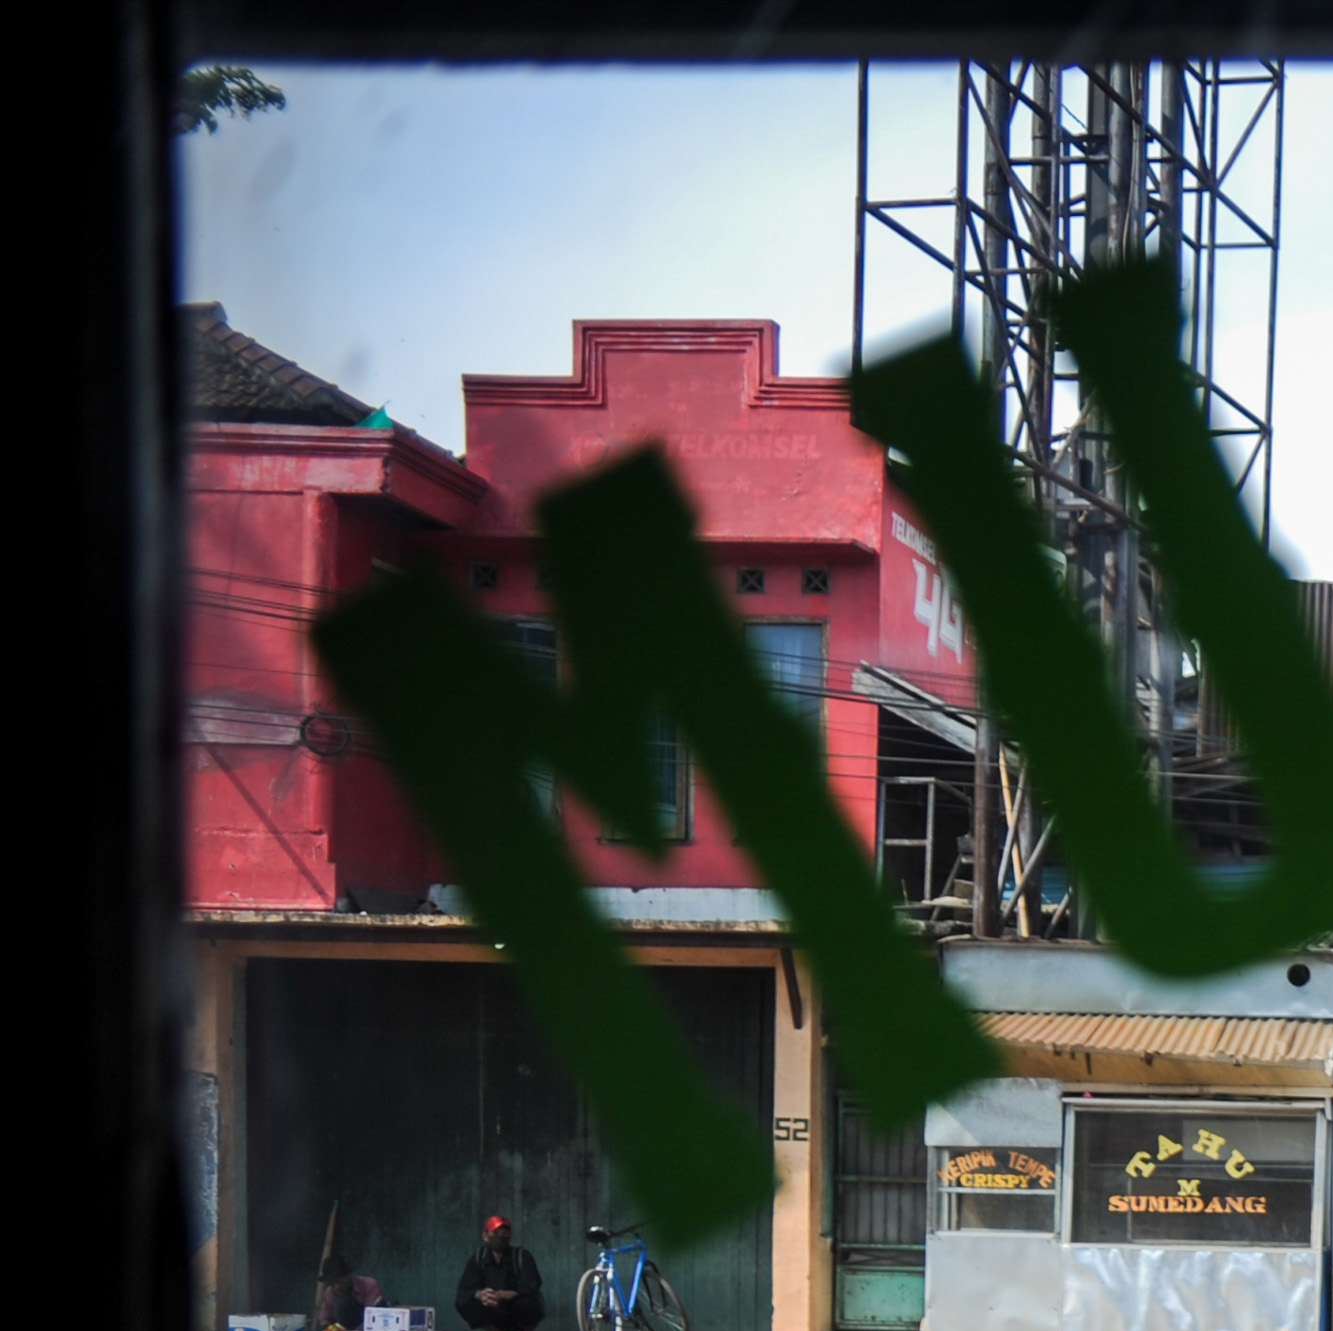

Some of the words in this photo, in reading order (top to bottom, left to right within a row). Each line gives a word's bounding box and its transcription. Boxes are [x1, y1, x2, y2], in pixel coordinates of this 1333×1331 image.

[775, 1117, 809, 1141] 52
[1125, 1128, 1255, 1180] TAHU
[1008, 1150, 1056, 1188] TEMPE
[960, 1173, 1030, 1188] CRISPY
[1177, 1179, 1201, 1196] M
[1108, 1195, 1267, 1214] SUMEDANG
